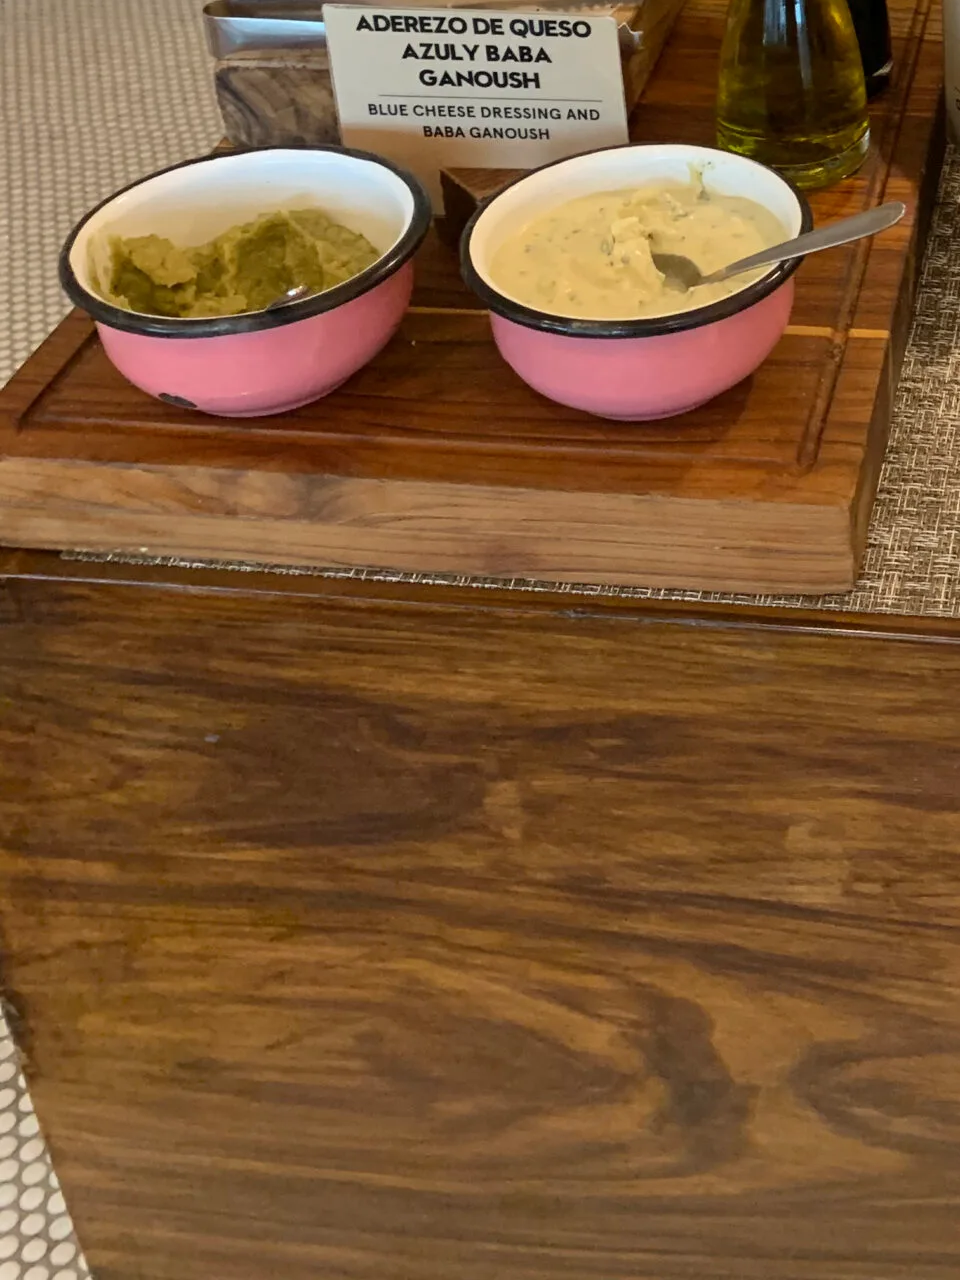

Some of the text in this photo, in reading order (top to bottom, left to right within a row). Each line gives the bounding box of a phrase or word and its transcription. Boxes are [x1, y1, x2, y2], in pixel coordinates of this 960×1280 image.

[356, 15, 591, 38] ADEREZO DE QUESO
[486, 45, 552, 63] BABA
[419, 70, 540, 89] GANOUSH
[368, 104, 600, 121] BLUE CHEESE DRESSING AND
[423, 126, 550, 140] BABA GANOUSH
